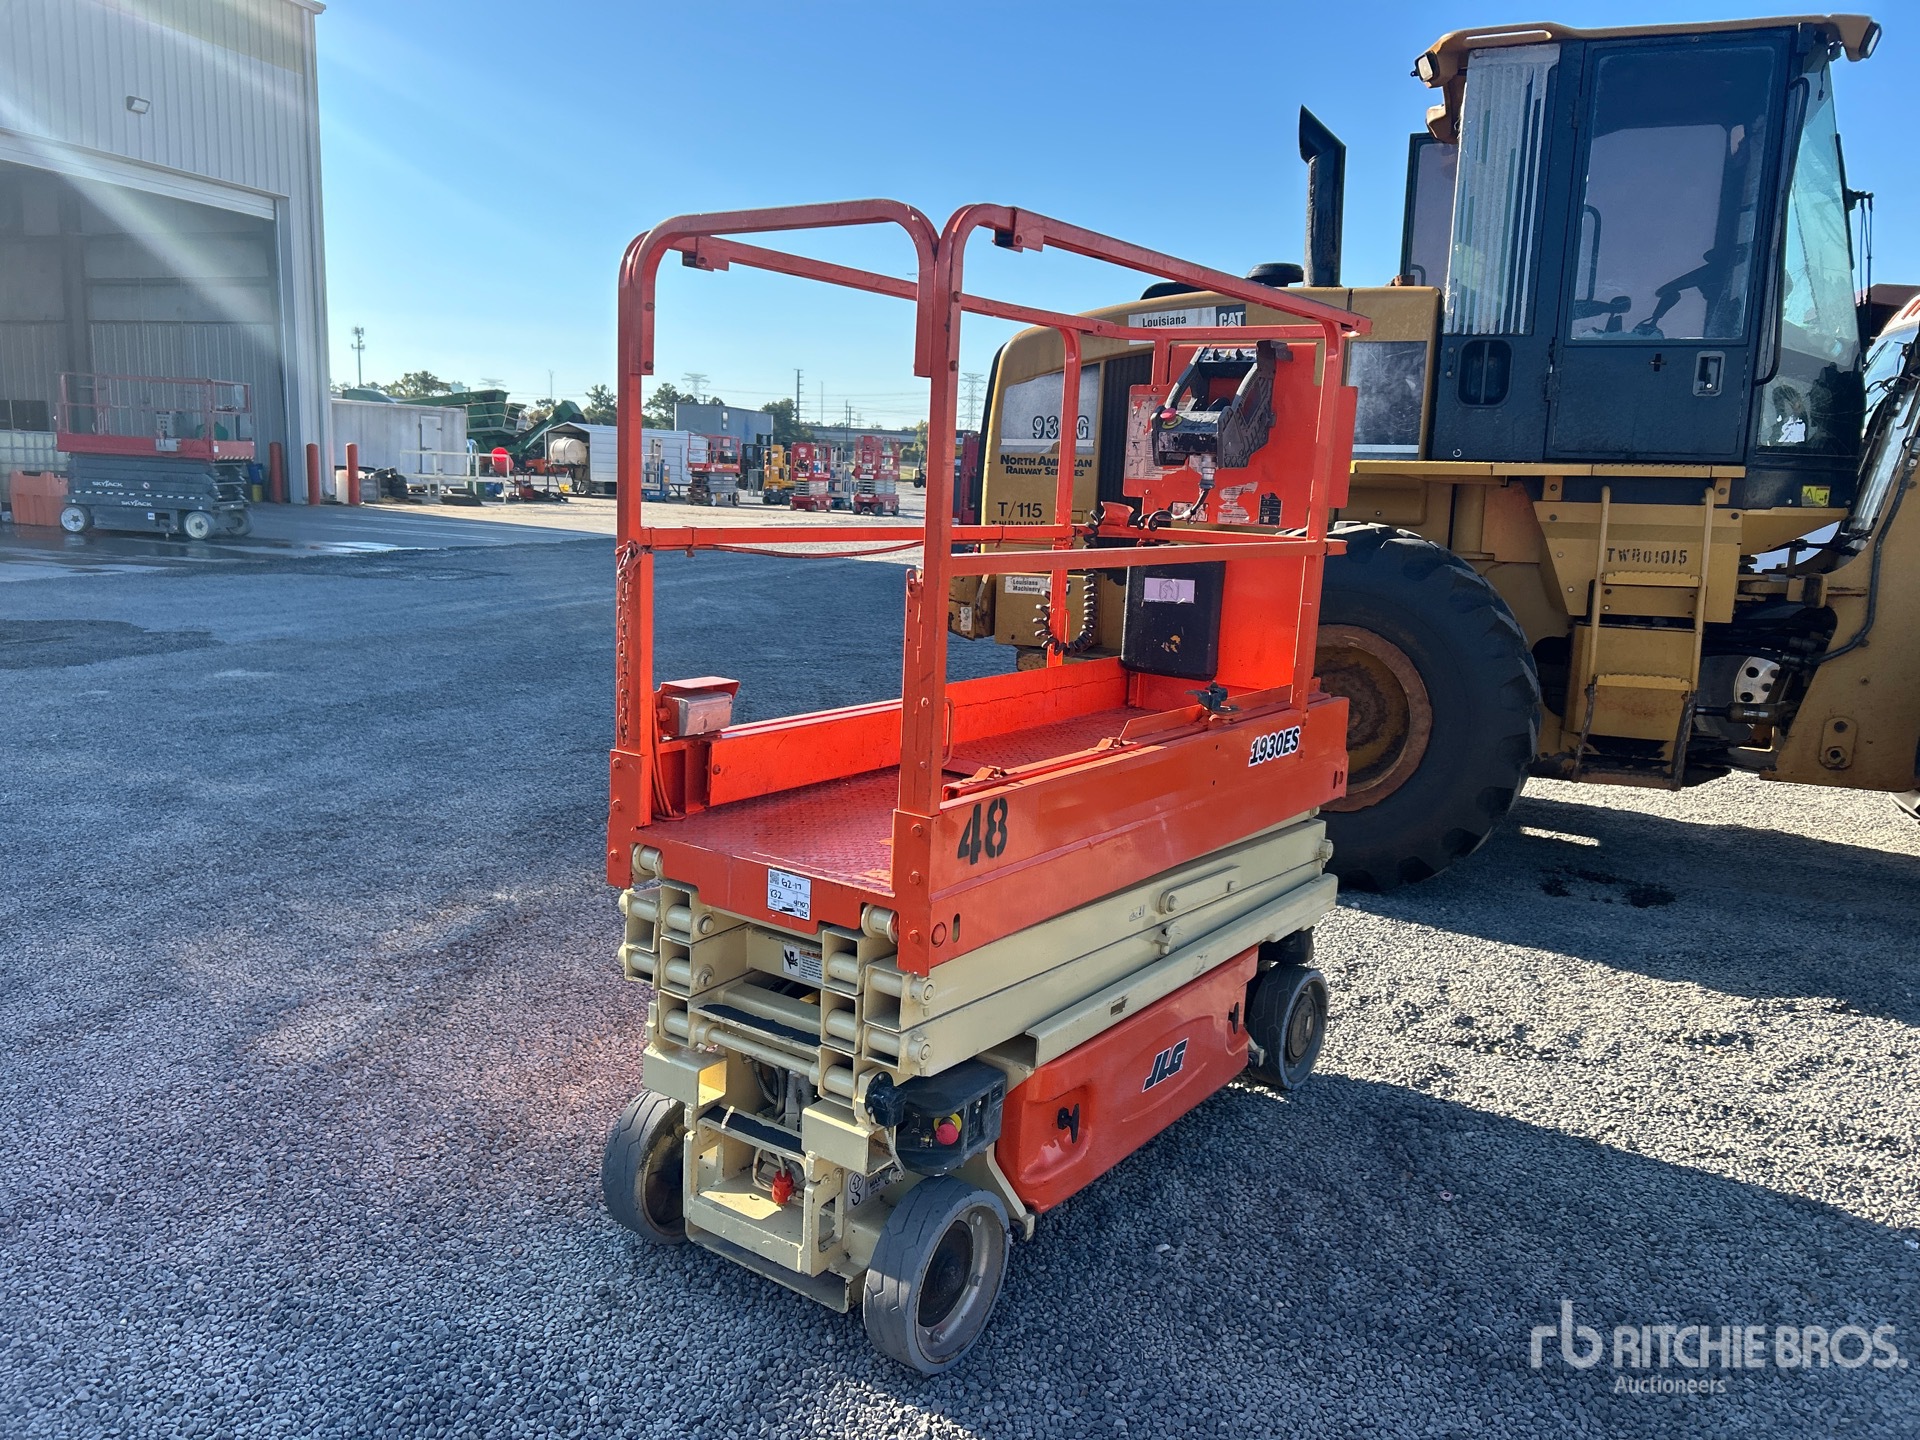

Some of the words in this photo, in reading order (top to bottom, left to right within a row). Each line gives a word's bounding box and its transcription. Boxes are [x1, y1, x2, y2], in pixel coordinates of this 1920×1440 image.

[1142, 315, 1187, 328] Louisiana
[1218, 311, 1243, 327] CAT
[1032, 415, 1089, 440] 93G
[1000, 455, 1036, 466] NORTH
[1005, 465, 1042, 475] RAILWAY
[998, 501, 1042, 518] T/115
[1248, 726, 1300, 767] 1930ES
[957, 797, 1008, 865] 48
[1142, 1038, 1189, 1093] JLG
